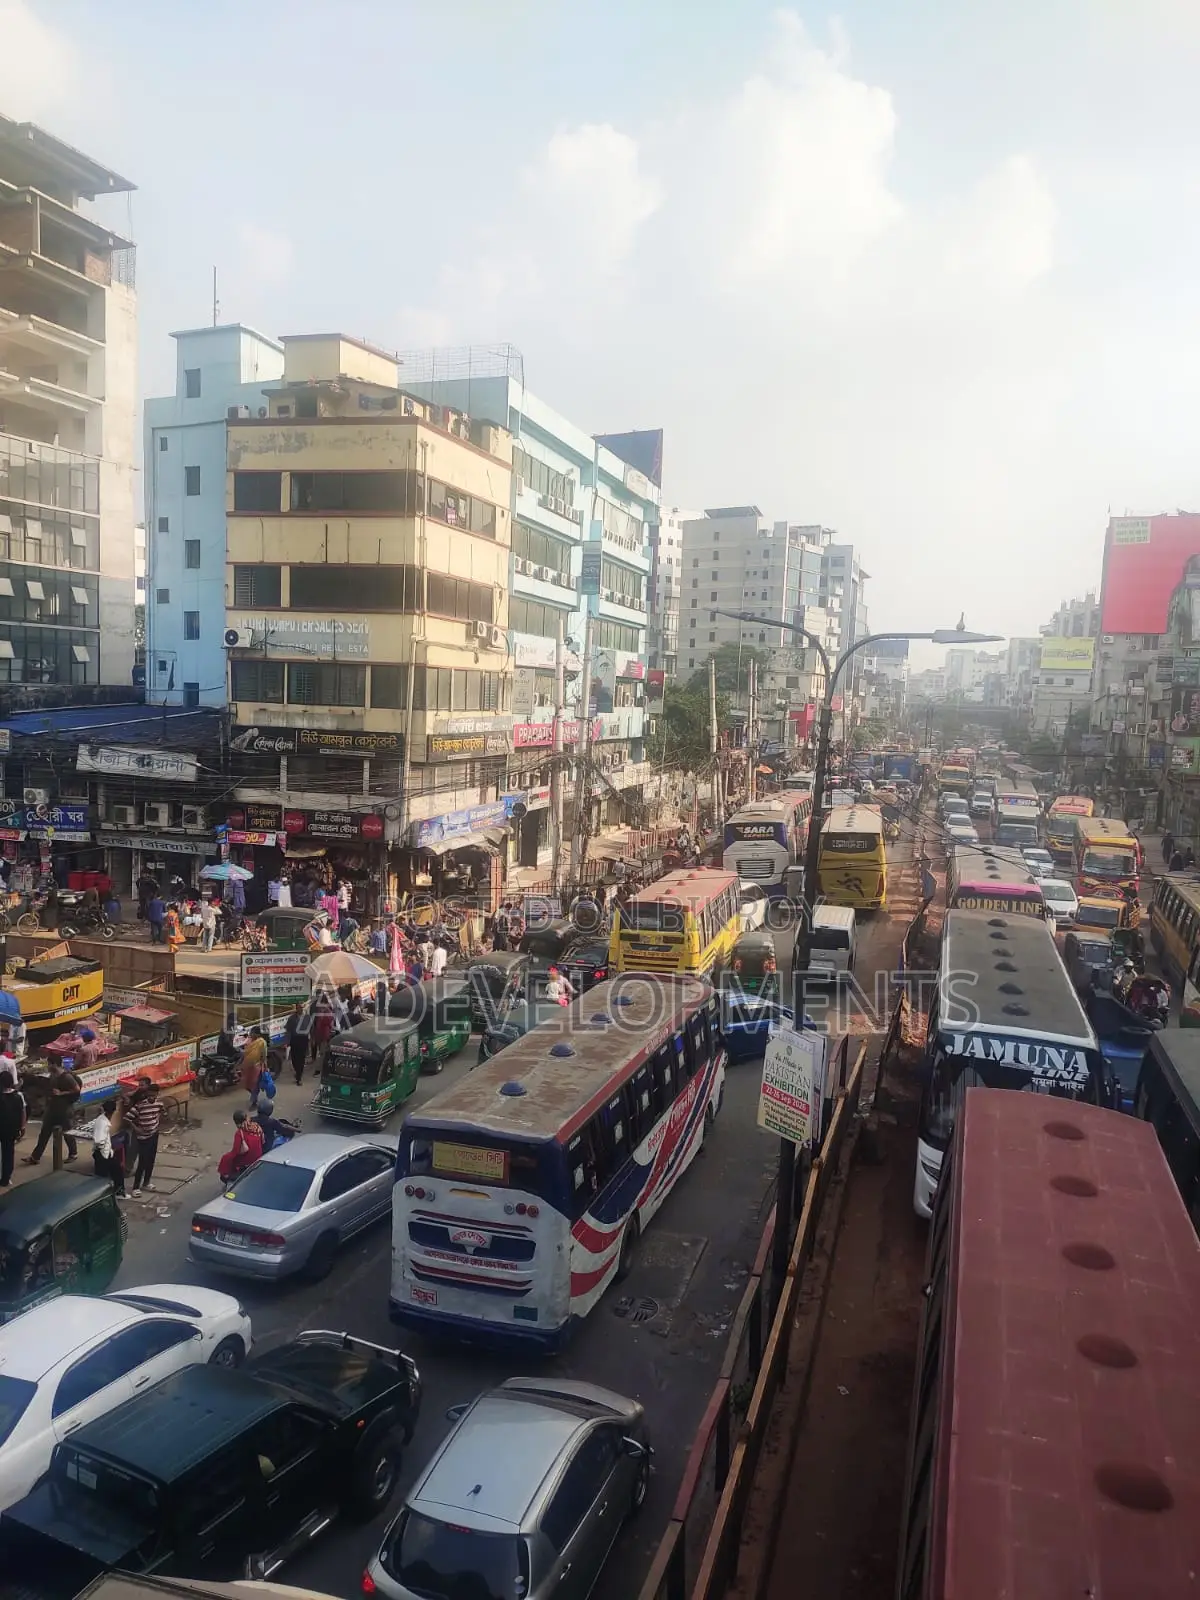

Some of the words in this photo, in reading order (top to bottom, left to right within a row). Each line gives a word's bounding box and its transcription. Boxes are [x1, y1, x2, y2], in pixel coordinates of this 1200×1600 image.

[67, 811, 84, 823] ঘর
[744, 826, 775, 834] SARA
[957, 897, 1008, 913] GOLDEN
[1012, 900, 1043, 915] LINE
[63, 983, 81, 1002] CAT
[945, 1034, 1091, 1074] JAMUNA
[765, 1059, 811, 1090] PAKISTAN
[1031, 1077, 1056, 1088] যমুনা
[1032, 1067, 1091, 1082] LINE
[765, 1072, 809, 1101] EXHIBITION
[780, 1092, 792, 1105] Sep
